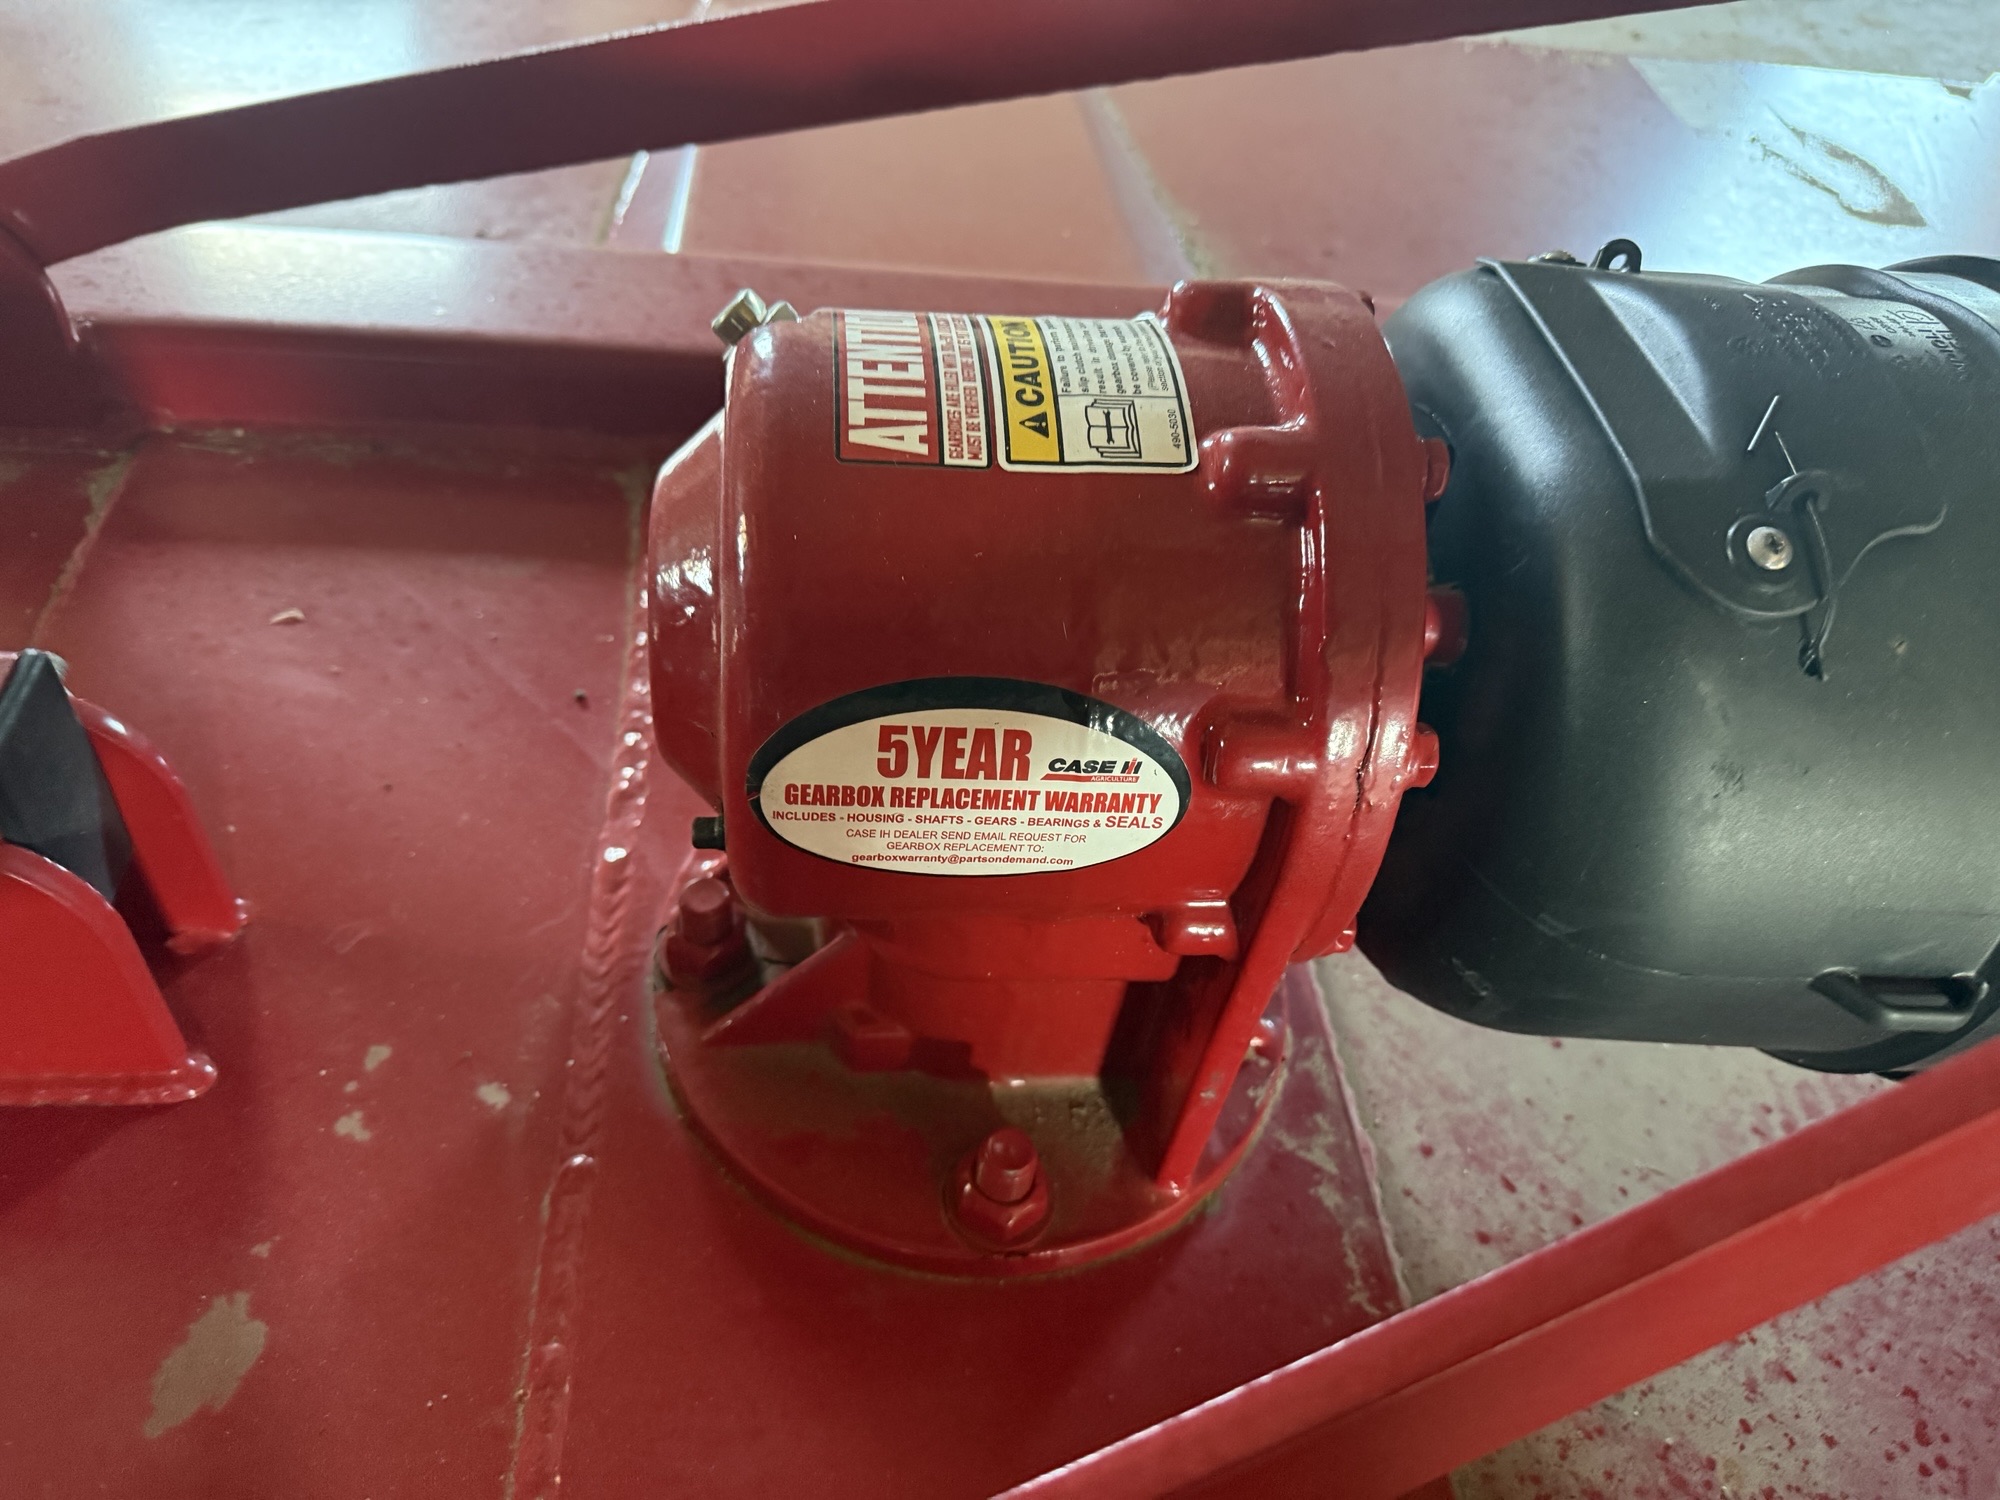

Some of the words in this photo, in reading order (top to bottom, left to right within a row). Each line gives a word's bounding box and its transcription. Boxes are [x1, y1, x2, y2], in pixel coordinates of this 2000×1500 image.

[999, 319, 1045, 407] CAUTION
[1057, 354, 1066, 363] to
[1072, 352, 1086, 375] clutch
[1124, 353, 1141, 382] covered
[1060, 365, 1072, 393] Failure
[1078, 376, 1089, 393] slip
[1094, 368, 1107, 394] result
[1111, 361, 1127, 394] gearbox
[1132, 384, 1142, 394] be
[946, 409, 965, 460] GEARBOXES
[965, 420, 981, 432] BE
[1167, 409, 1181, 450] 490-5030
[966, 433, 982, 460] MUST
[876, 724, 1033, 781] 5YEAR
[1047, 757, 1118, 774] CASE
[1090, 775, 1137, 783] AGRICULTURE
[784, 783, 886, 807] GEARBOX
[889, 786, 1041, 811] REPLACEMENT
[1044, 790, 1163, 814] WARRANTY
[772, 810, 836, 822] INCLUDES
[846, 813, 905, 823] HOUSING
[915, 815, 964, 825] SHAFTS
[974, 816, 1017, 826] GEARS
[1027, 817, 1090, 828] BEARINGS
[1093, 819, 1101, 828] &
[1104, 815, 1164, 829] SEALS
[846, 829, 877, 838] CASE
[879, 829, 891, 839] IH
[893, 830, 938, 840] DEALER
[940, 831, 972, 840] SEND
[974, 831, 1006, 841] EMAIL
[1009, 832, 1062, 842] REQUEST
[1063, 833, 1087, 843] FOR
[886, 841, 941, 851] GEARBOX
[943, 842, 1025, 852] REPLACEMENT
[1026, 843, 1044, 853] TO:
[851, 853, 1074, 866] gearboxwarranty@partsondemand.com
